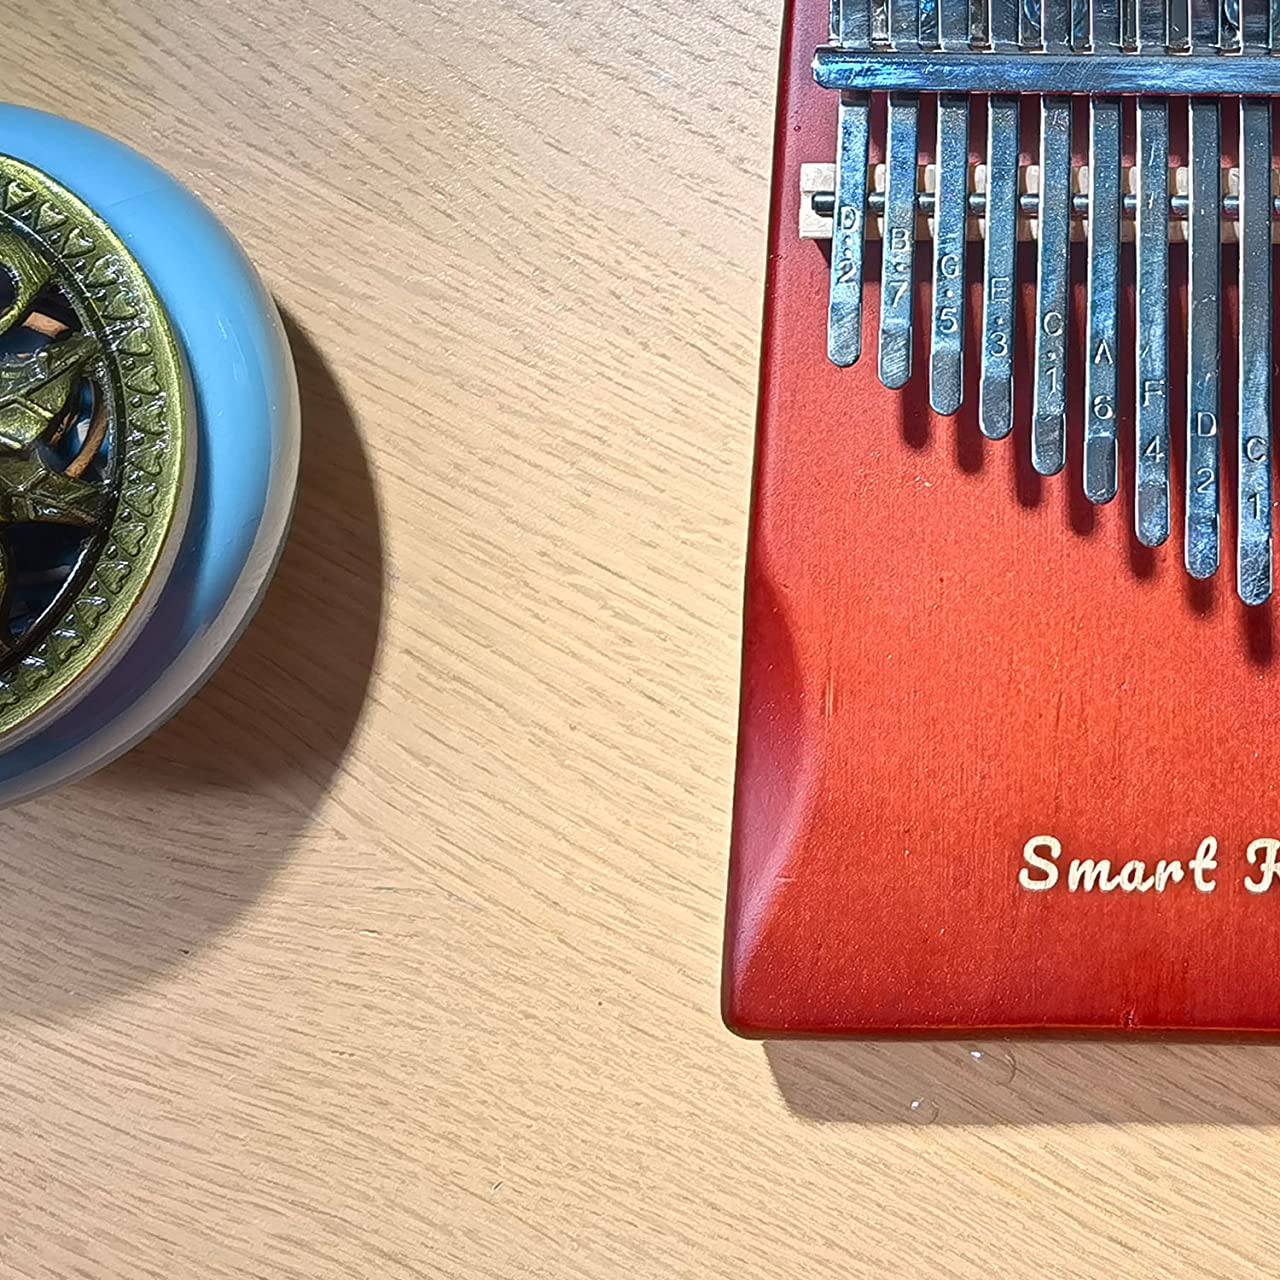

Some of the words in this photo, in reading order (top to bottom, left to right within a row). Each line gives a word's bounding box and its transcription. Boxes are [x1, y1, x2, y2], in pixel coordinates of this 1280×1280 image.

[841, 206, 861, 231] D
[890, 227, 911, 251] B
[838, 260, 858, 283] 2
[940, 254, 961, 278] G
[889, 281, 909, 308] 7
[990, 277, 1011, 305] E
[939, 308, 959, 334] 5
[1043, 311, 1063, 337] C
[989, 331, 1008, 357] 3
[1093, 338, 1114, 365] A
[1143, 379, 1166, 407] F
[1093, 394, 1114, 420] 6
[1197, 411, 1217, 437] D
[1145, 435, 1165, 463] 4
[1246, 435, 1267, 463] C
[1196, 467, 1216, 494] 2
[1018, 834, 1218, 894] Smart
